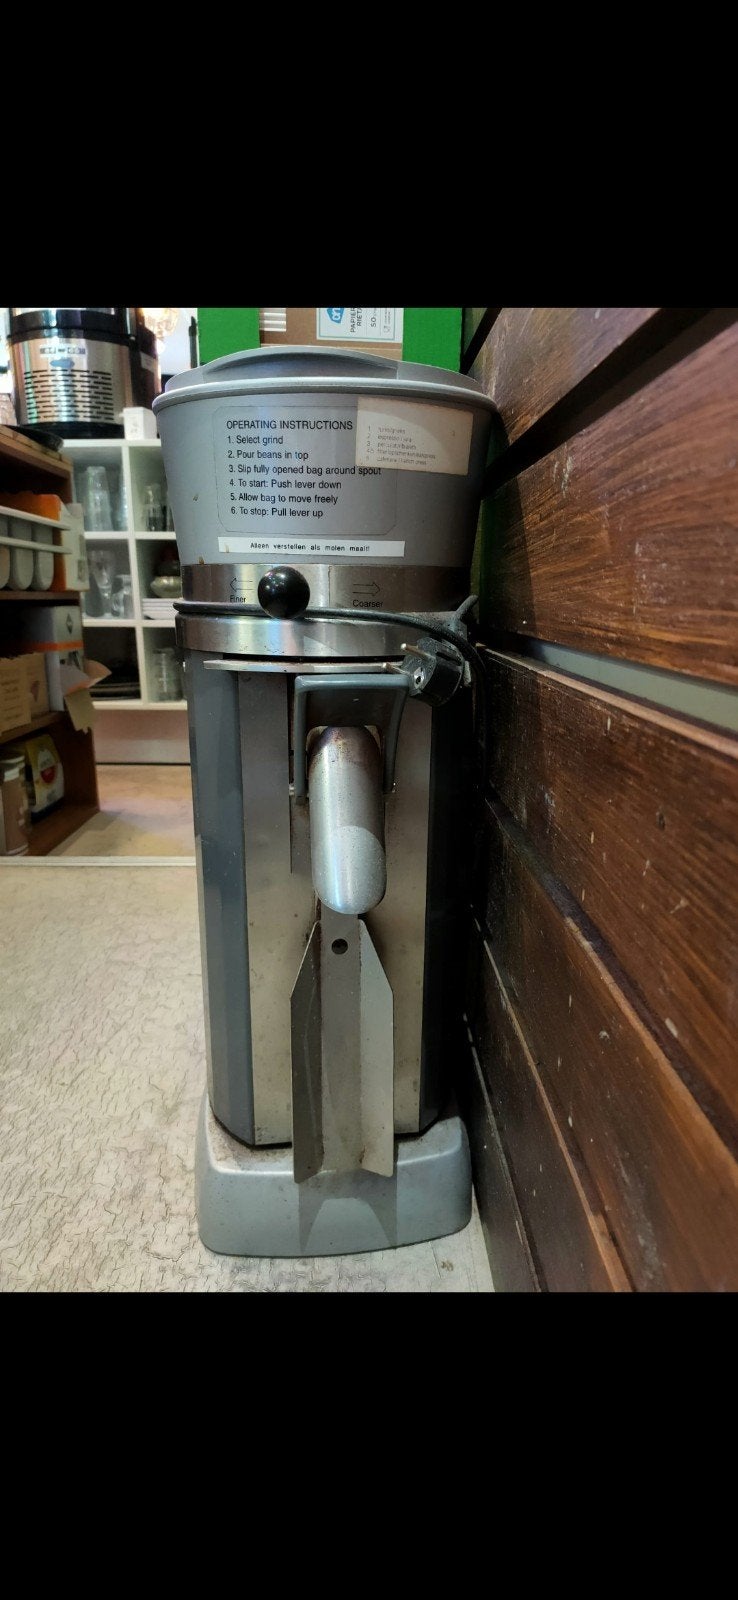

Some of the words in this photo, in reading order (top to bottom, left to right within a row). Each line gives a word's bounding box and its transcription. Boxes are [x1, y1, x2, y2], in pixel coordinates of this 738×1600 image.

[226, 420, 277, 430] OPERATING
[280, 420, 353, 430] INSTRUCTIONS
[227, 435, 234, 444] 1.
[236, 435, 260, 444] Select
[262, 435, 284, 446] grind
[227, 449, 235, 459] 2.
[236, 449, 255, 459] Pour
[257, 449, 282, 459] beans
[284, 450, 293, 459] in
[294, 450, 309, 461] top
[228, 464, 236, 473] 3.
[237, 464, 251, 475] Slip
[253, 464, 270, 475] fully
[272, 465, 304, 475] opened
[306, 465, 323, 477] bag
[325, 465, 356, 475] around
[358, 467, 382, 477] spout
[229, 478, 236, 487] 4.
[238, 478, 247, 487] To
[249, 479, 269, 488] start:
[271, 478, 293, 489] Push
[294, 480, 316, 489] lever
[318, 480, 342, 490] down
[230, 492, 237, 501] 5.
[238, 492, 259, 501] Allow
[260, 493, 276, 504] bag
[277, 494, 287, 502] to
[314, 494, 338, 506] freely
[230, 506, 238, 515] 6.
[239, 506, 248, 515] To
[250, 507, 269, 517] stop:
[271, 507, 287, 517] Pull
[289, 508, 310, 517] lever
[312, 510, 324, 519] up
[250, 542, 270, 550] Alleen
[273, 543, 306, 551] verstellen
[229, 594, 247, 604] Finer
[352, 599, 384, 609] Coarser
